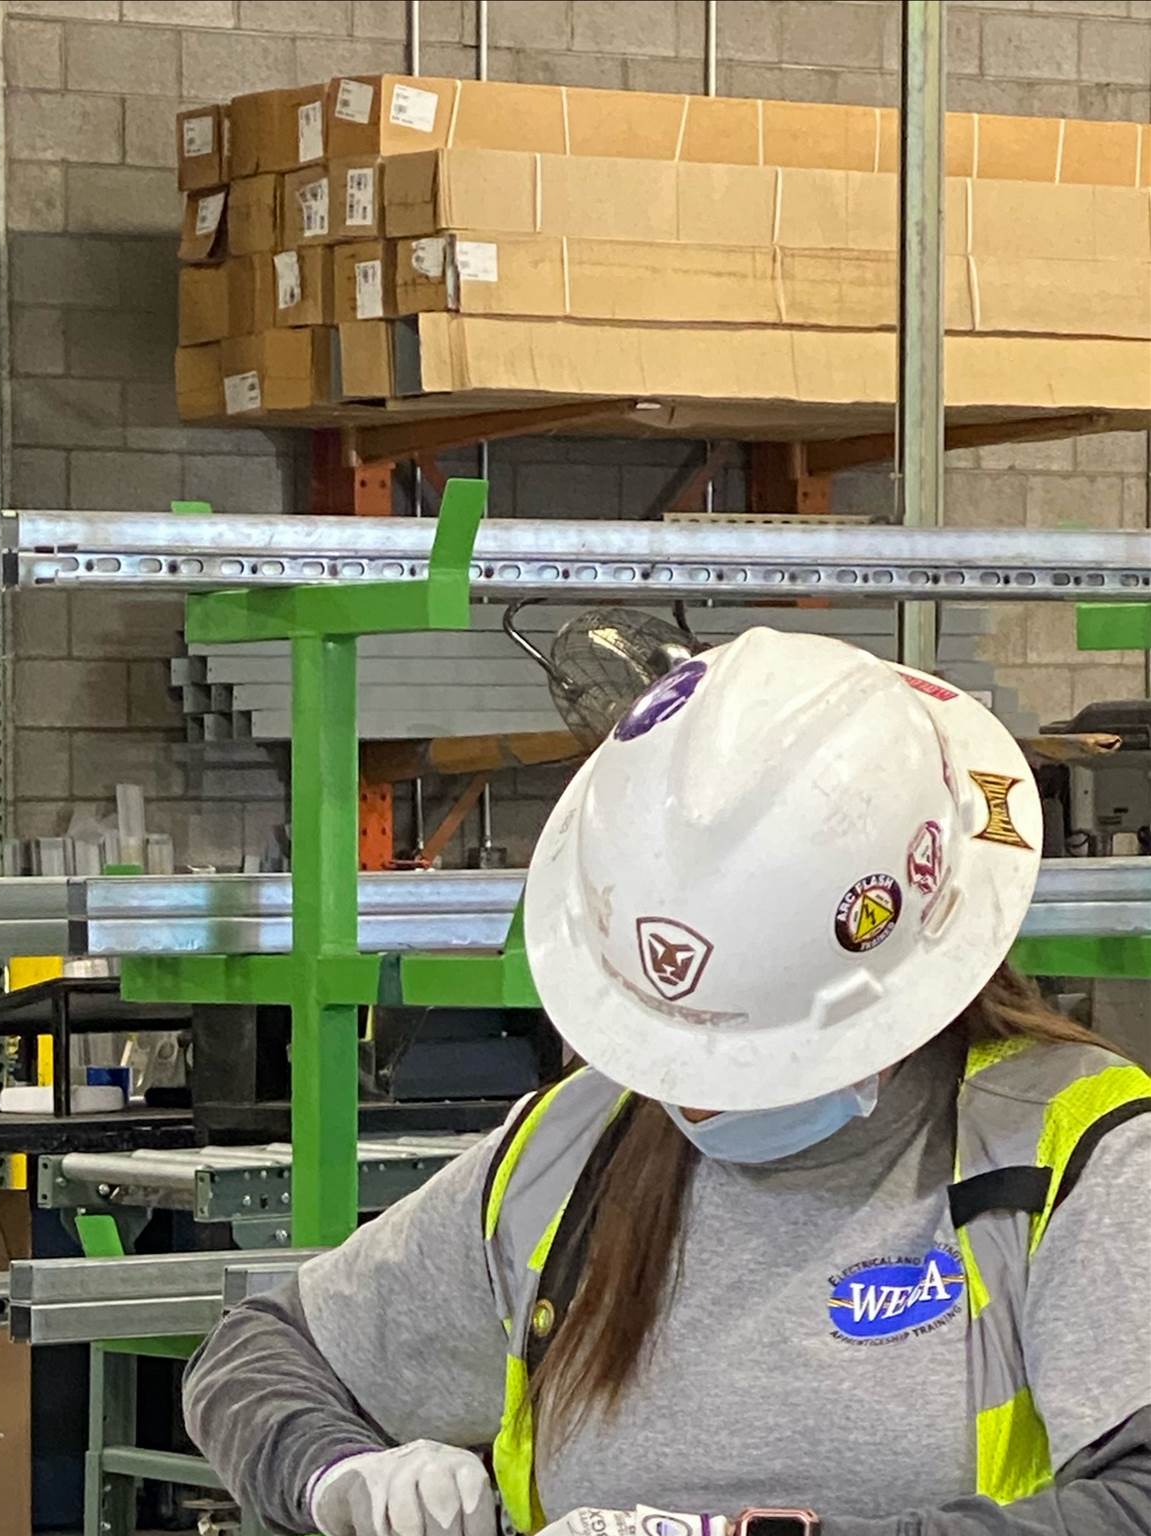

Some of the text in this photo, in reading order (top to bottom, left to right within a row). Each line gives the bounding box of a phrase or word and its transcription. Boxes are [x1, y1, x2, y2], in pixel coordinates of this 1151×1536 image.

[836, 874, 894, 922] ARC FLASH
[827, 1256, 894, 1287] ELECTRICAL
[896, 1256, 921, 1266] AND
[912, 1305, 962, 1338] TRAINING
